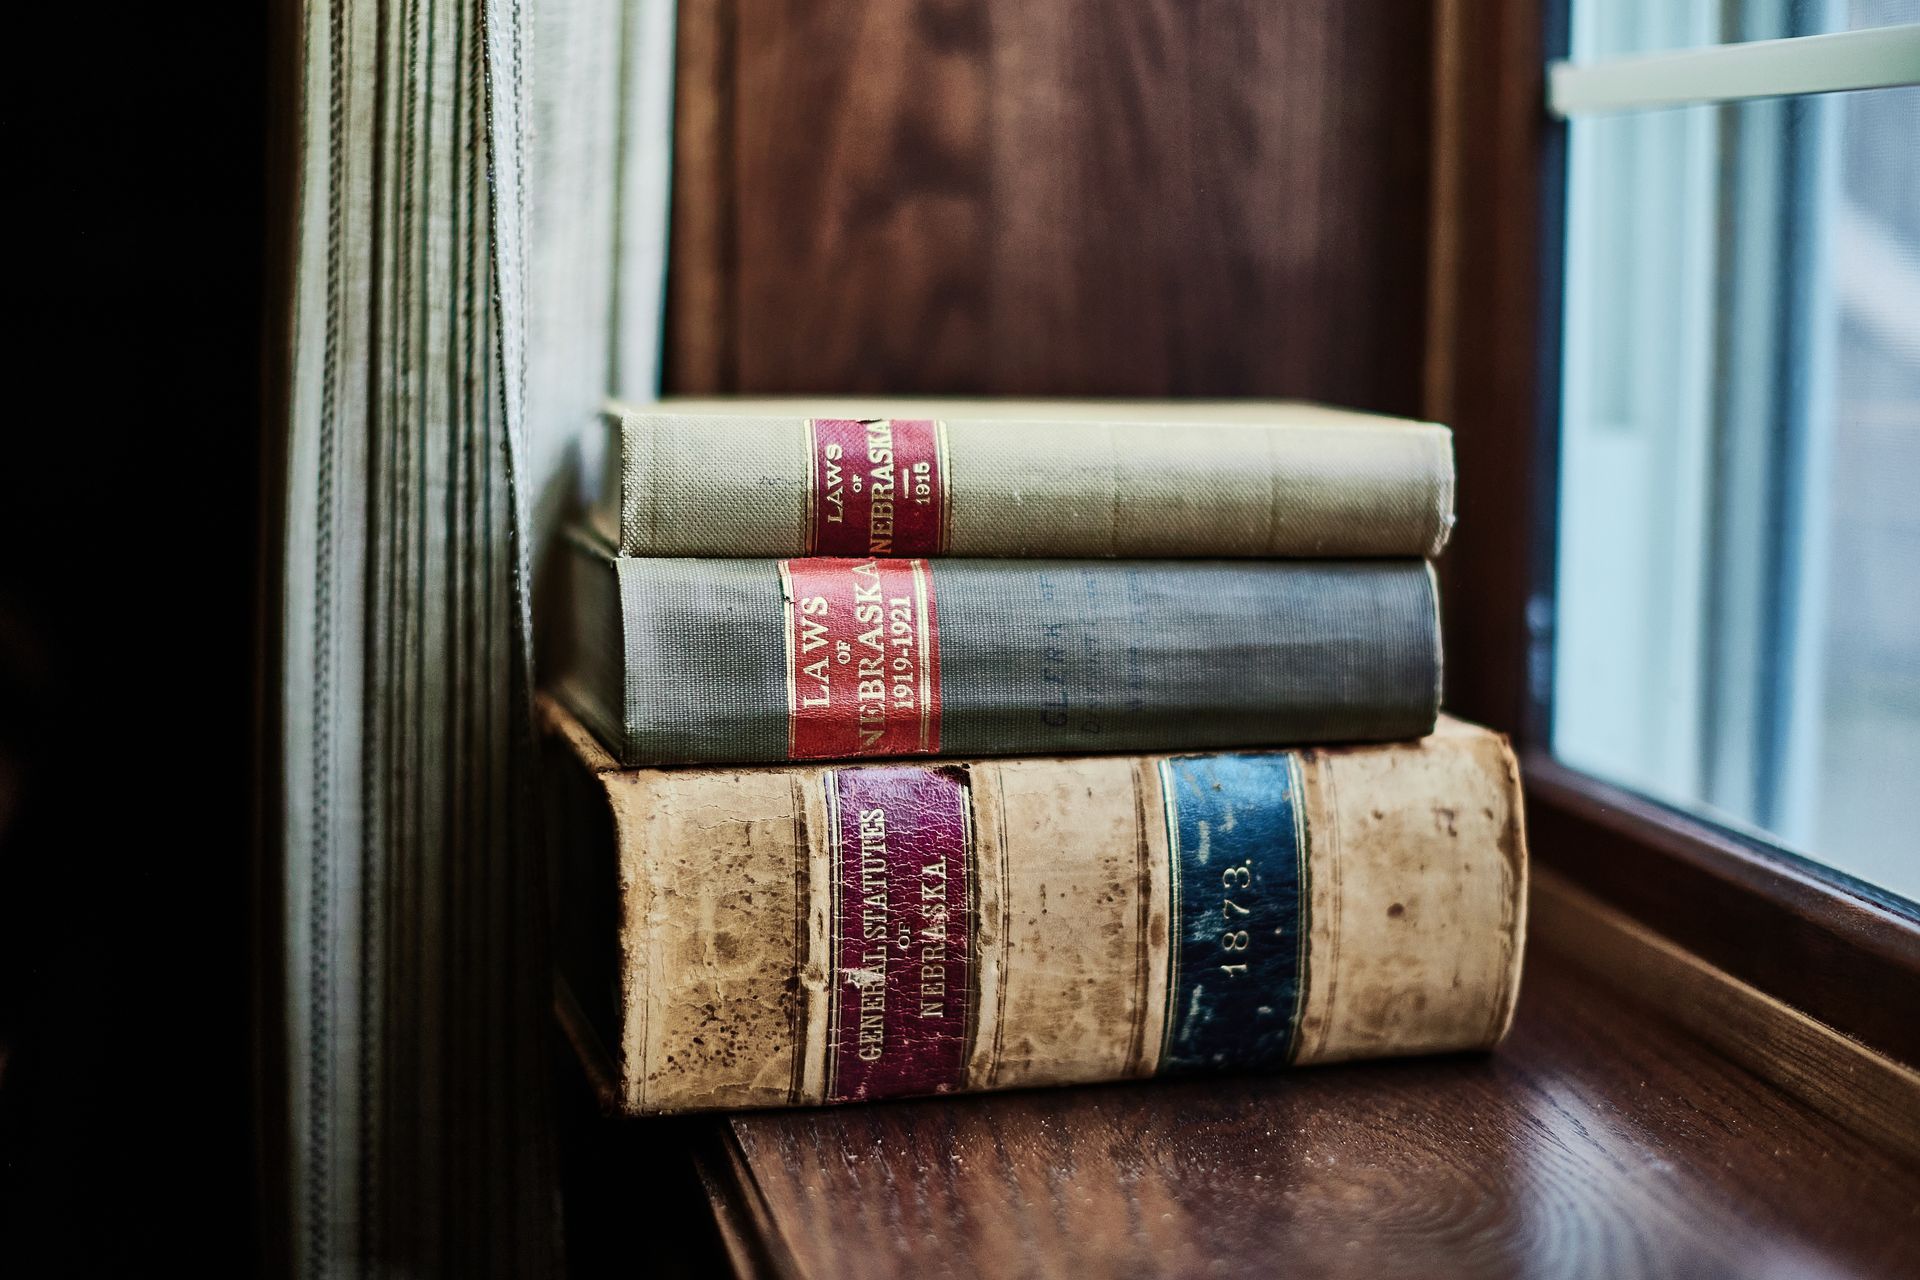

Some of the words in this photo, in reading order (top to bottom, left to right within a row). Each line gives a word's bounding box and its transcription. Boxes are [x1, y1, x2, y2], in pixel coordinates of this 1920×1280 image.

[827, 443, 843, 524] LAWS
[852, 474, 862, 493] OF
[866, 420, 895, 554] NEBRASKA
[801, 596, 830, 708] LAWS
[837, 639, 851, 665] OF
[852, 561, 886, 748] NEBRASKA
[890, 596, 915, 710] 1919-1921
[861, 808, 888, 939] STATUTES
[898, 921, 911, 950] OF
[859, 945, 887, 1061] GENERAL
